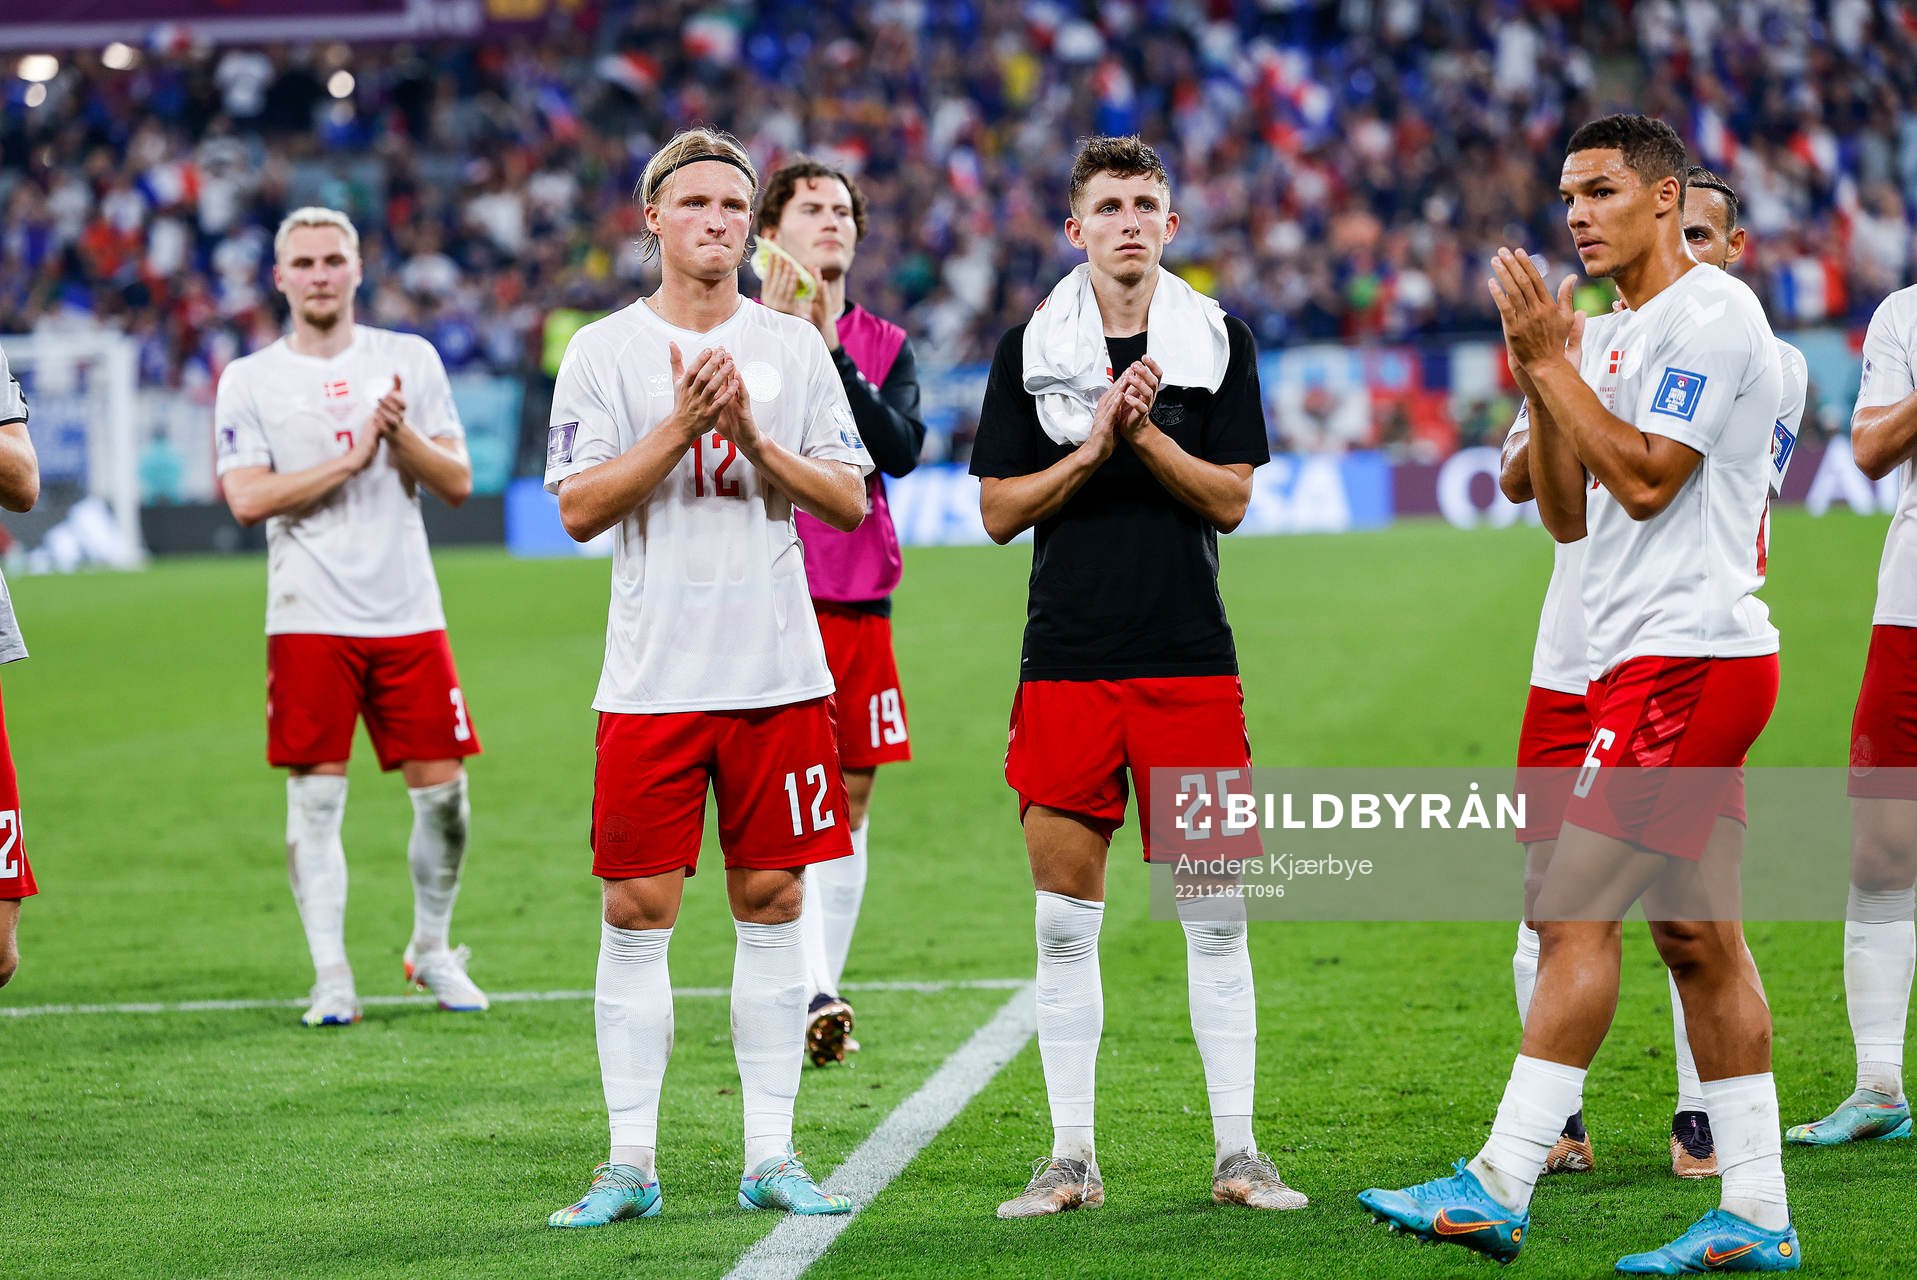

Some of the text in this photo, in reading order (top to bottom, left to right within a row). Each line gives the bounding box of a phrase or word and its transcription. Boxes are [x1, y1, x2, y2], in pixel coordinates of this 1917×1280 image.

[690, 433, 740, 497] 12
[449, 687, 471, 741] 3
[868, 687, 908, 748] 19
[1573, 727, 1616, 798] 6
[784, 763, 836, 836] 12
[1180, 769, 1246, 840] 25
[0, 808, 25, 879] 2
